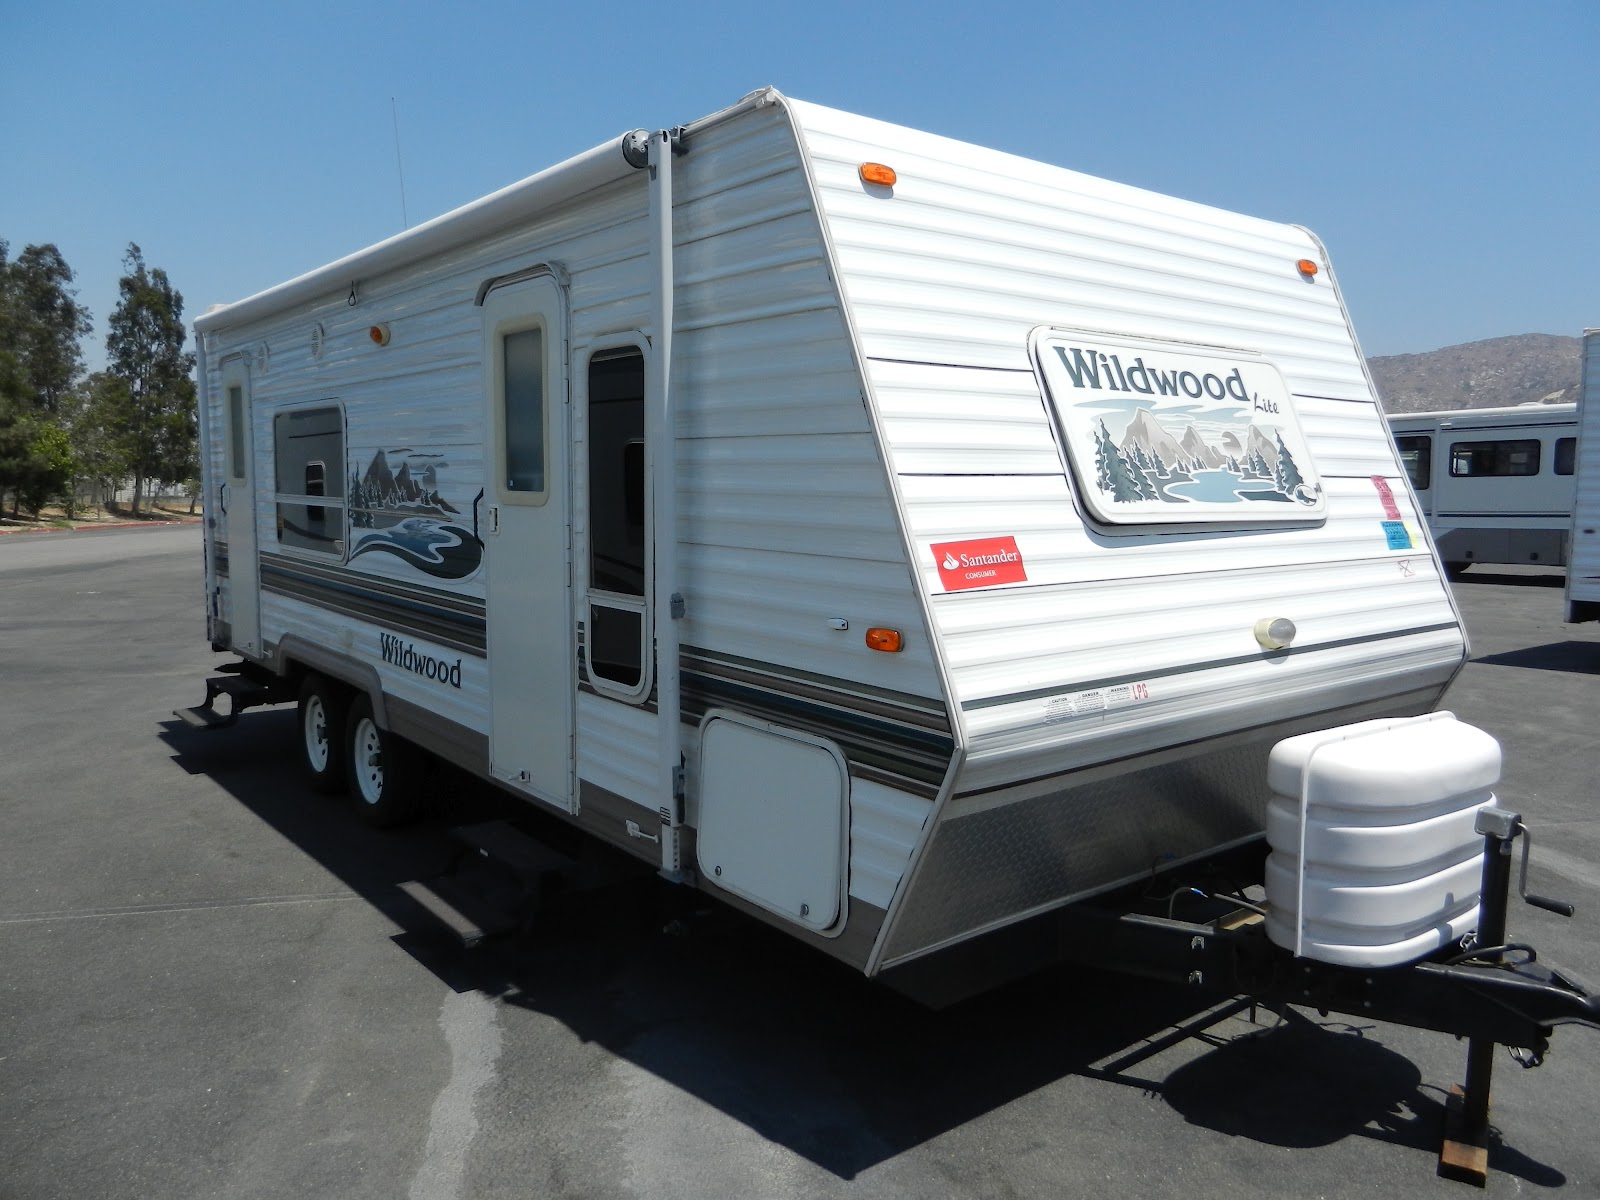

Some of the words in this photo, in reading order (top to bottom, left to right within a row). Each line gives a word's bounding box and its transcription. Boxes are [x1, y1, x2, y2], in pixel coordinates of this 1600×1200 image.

[1053, 346, 1250, 402] Wildwood
[1254, 392, 1280, 414] Lite
[960, 549, 1018, 567] Santander
[965, 570, 996, 579] CONSUMER
[380, 632, 462, 689] Wildwood
[1132, 683, 1149, 700] LPG
